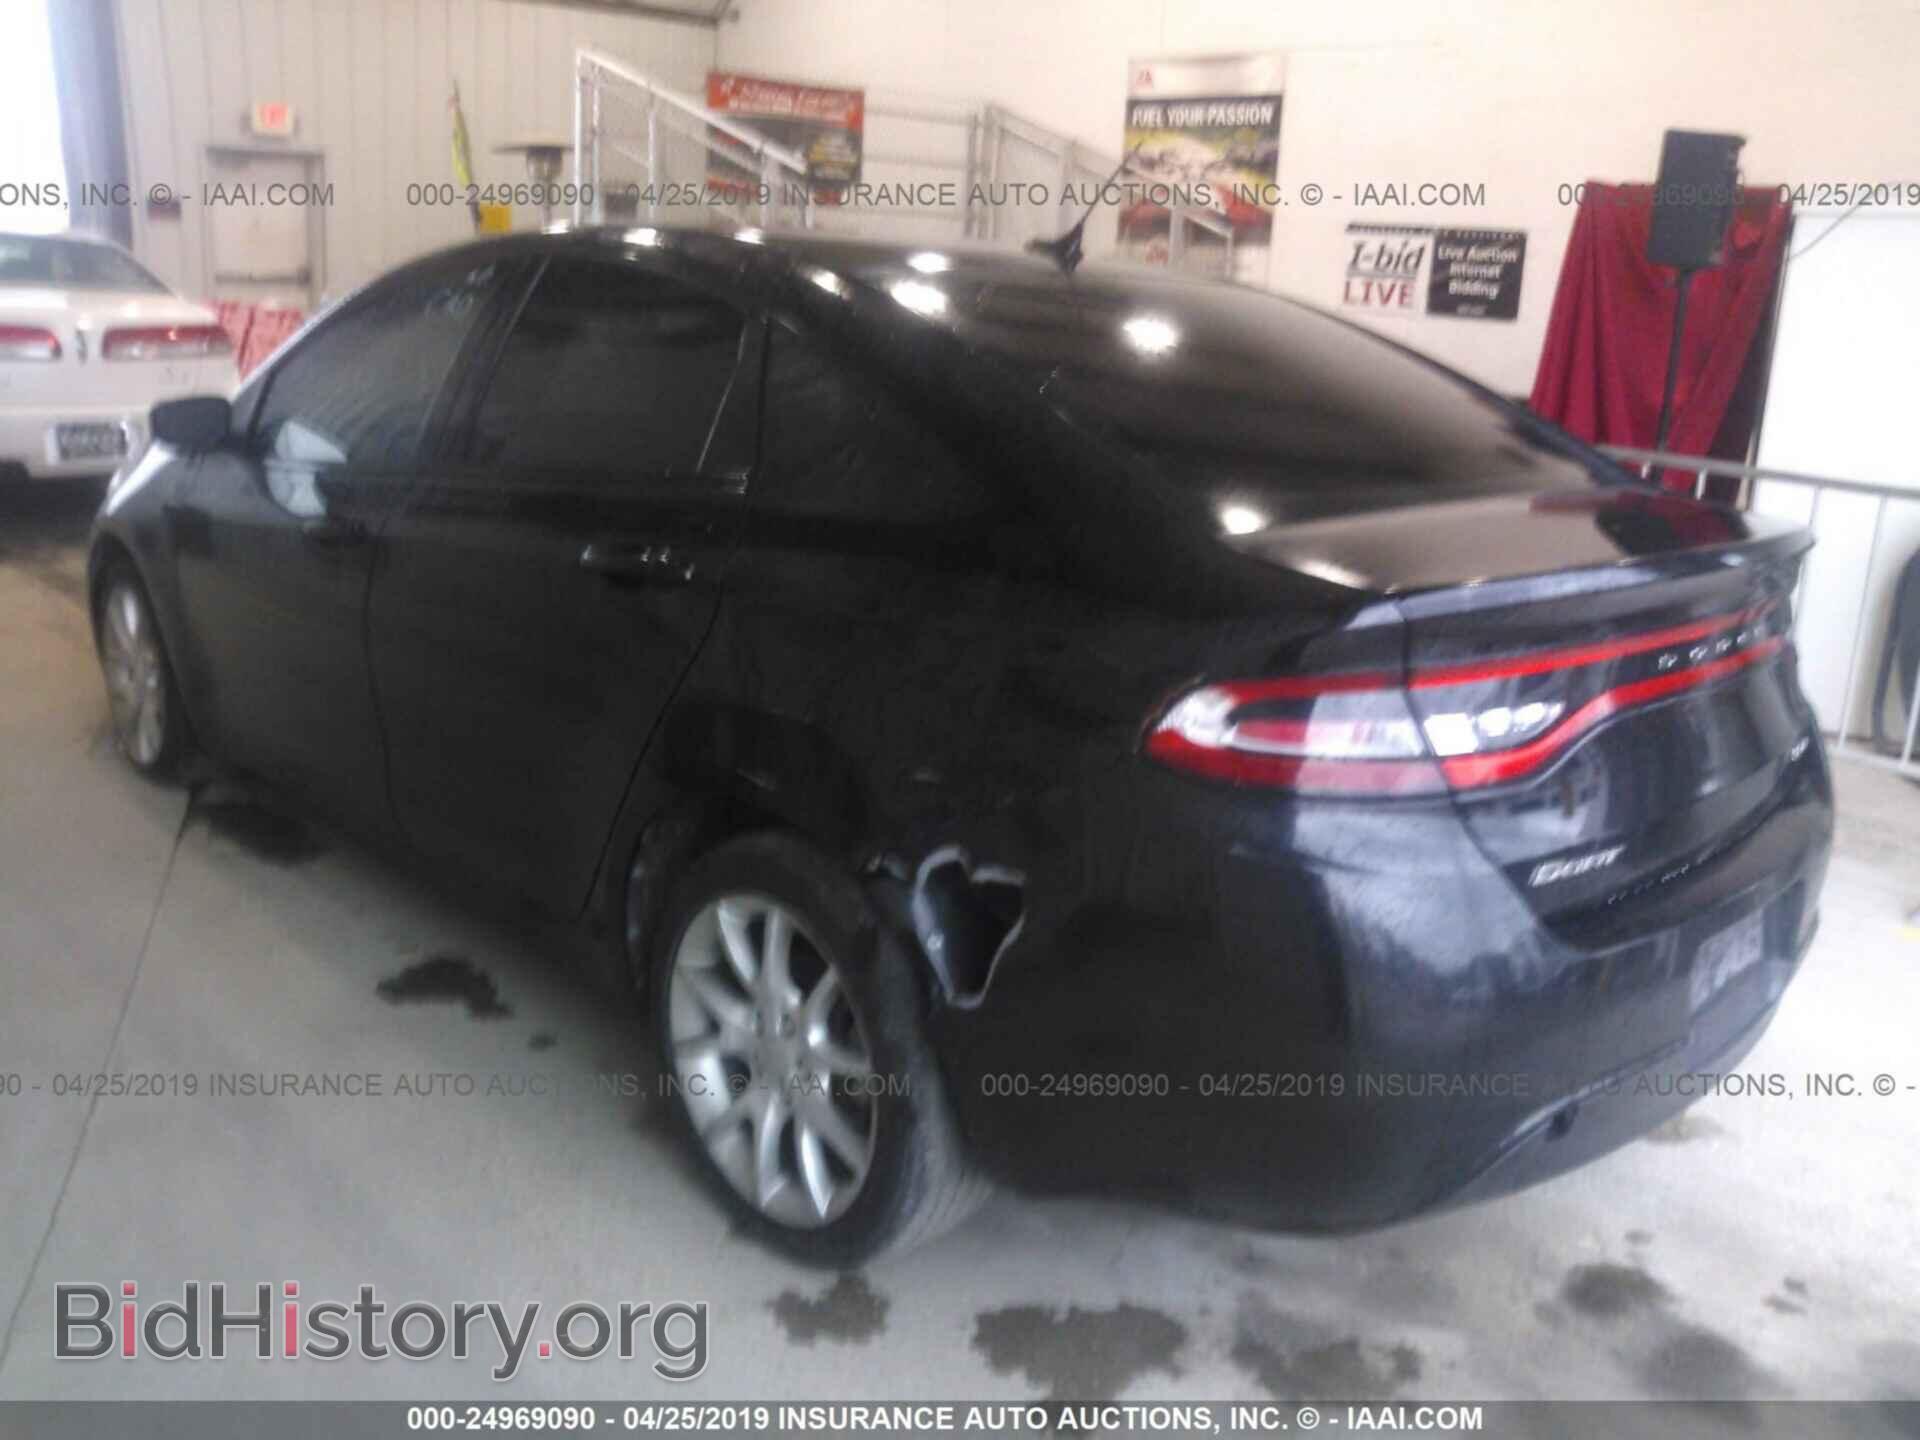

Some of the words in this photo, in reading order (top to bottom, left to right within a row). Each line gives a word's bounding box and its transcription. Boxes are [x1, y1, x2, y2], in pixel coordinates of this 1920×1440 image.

[1132, 105, 1163, 127] FUEL
[1167, 104, 1203, 127] YOUR
[1207, 103, 1274, 126] PASSION
[1349, 239, 1426, 273] I-bid
[1438, 245, 1465, 262] Live
[1467, 246, 1518, 263] Auction
[1449, 263, 1502, 279] Internet
[1343, 280, 1416, 305] LIVE
[1448, 282, 1499, 300] Bidding
